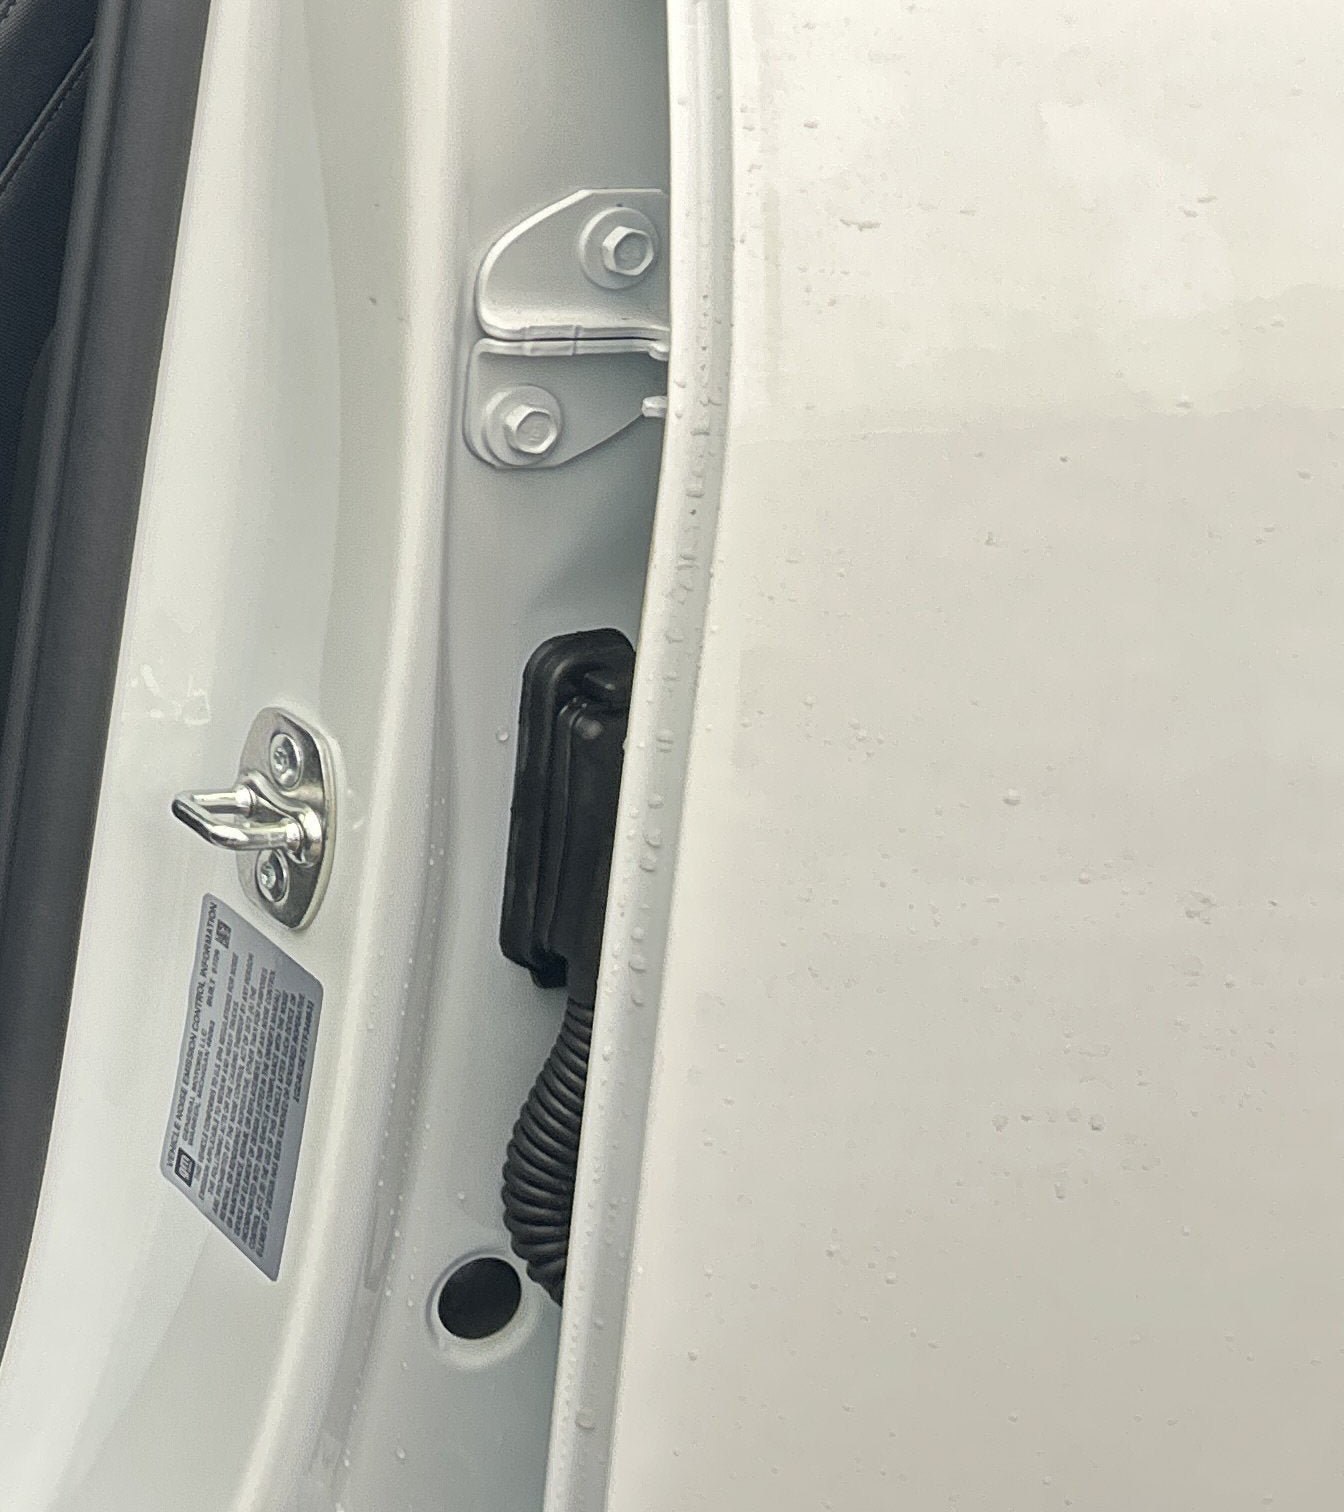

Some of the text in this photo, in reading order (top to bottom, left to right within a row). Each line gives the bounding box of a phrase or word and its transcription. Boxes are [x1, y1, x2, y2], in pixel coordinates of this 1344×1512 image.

[166, 901, 216, 1166] VEHICLE NOISE EMISSION CONTROL INFORMATION
[196, 1049, 209, 1098] MICHIGAN
[182, 1096, 195, 1140] GENERAL
[191, 1050, 203, 1092] MOTORS
